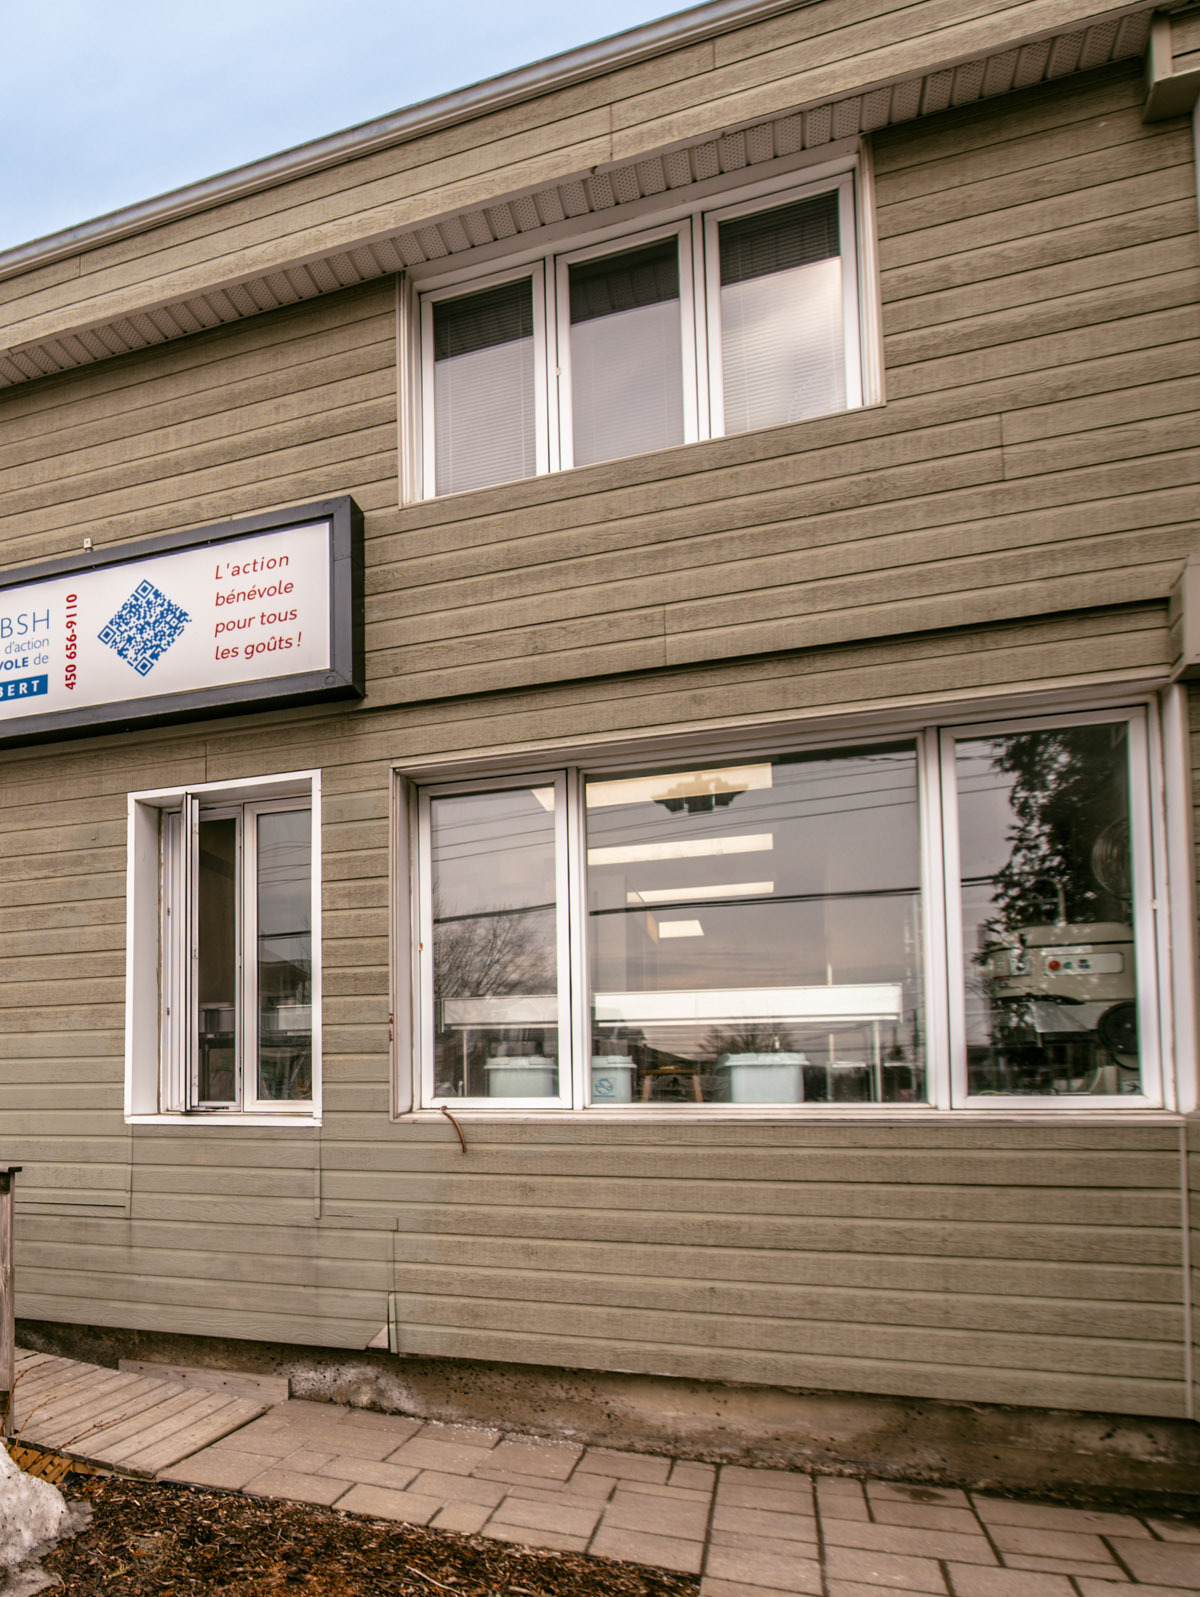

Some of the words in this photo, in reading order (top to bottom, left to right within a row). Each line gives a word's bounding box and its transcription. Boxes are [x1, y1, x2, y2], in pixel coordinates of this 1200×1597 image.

[215, 555, 289, 579] L'action
[215, 580, 294, 606] bénévole
[65, 594, 77, 660] 656-9110
[215, 616, 255, 638] pour
[260, 608, 297, 625] tous
[5, 638, 50, 655] d'action
[33, 652, 49, 665] de
[215, 645, 239, 660] les
[65, 664, 77, 690] 450
